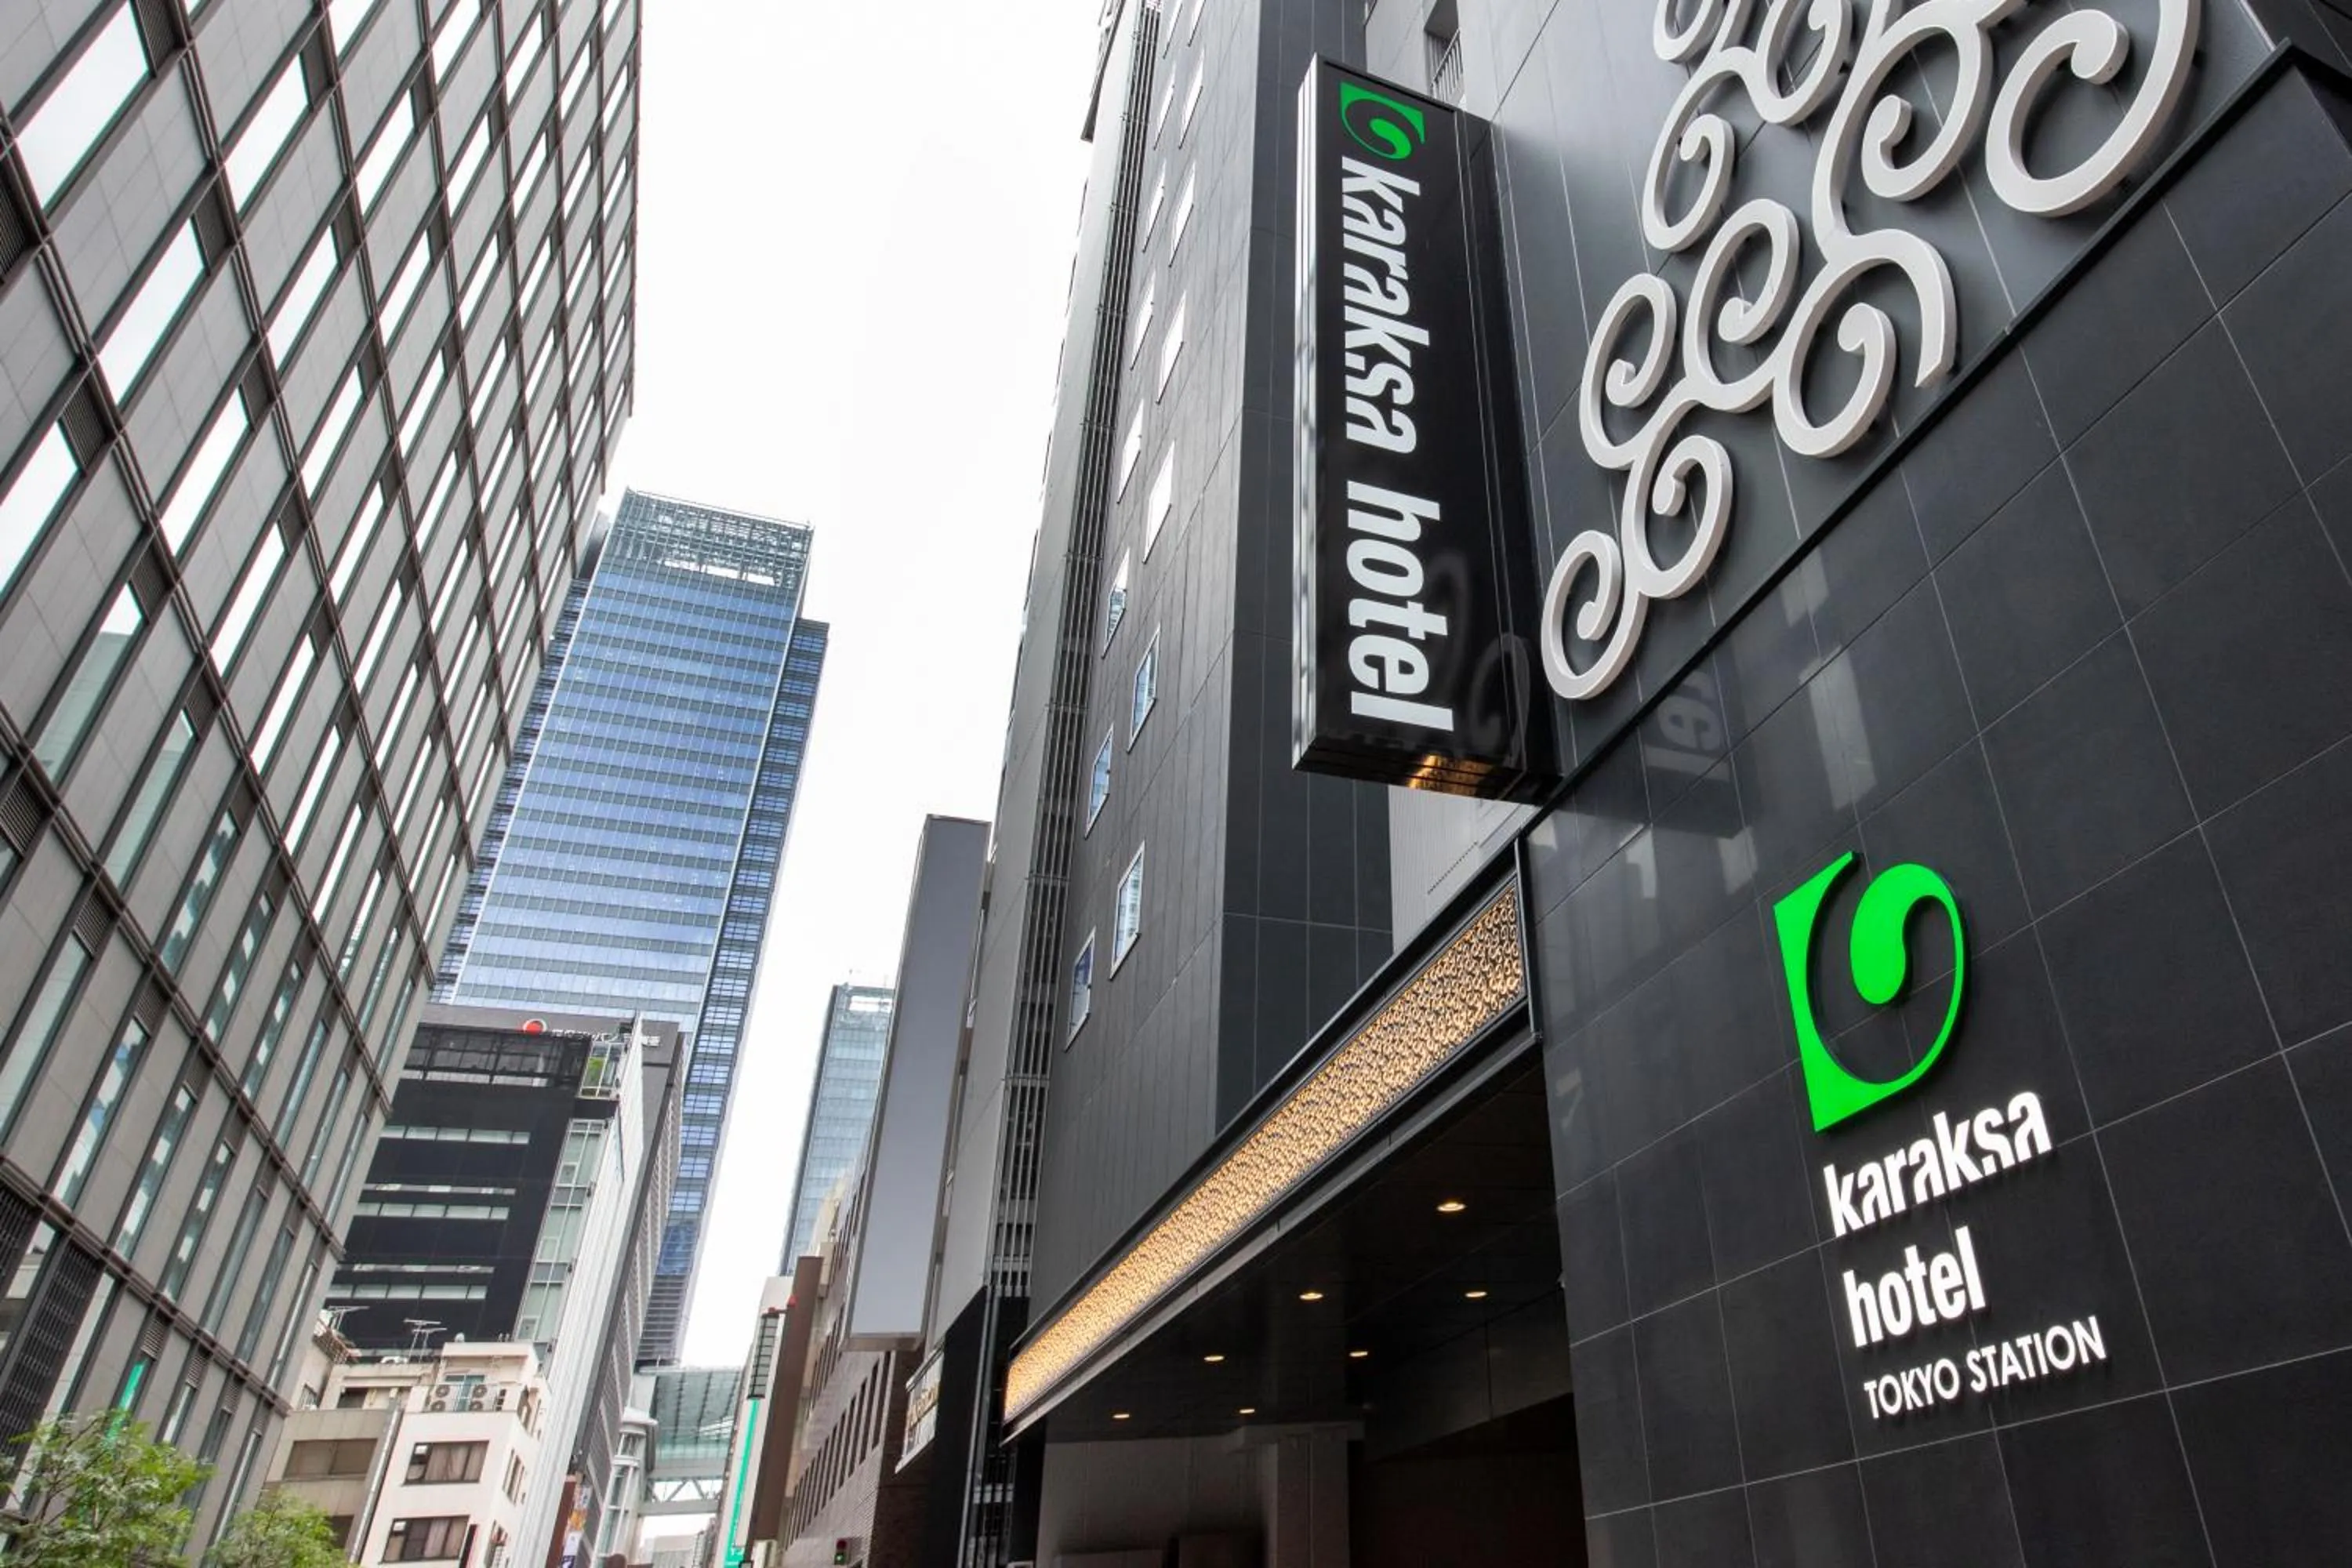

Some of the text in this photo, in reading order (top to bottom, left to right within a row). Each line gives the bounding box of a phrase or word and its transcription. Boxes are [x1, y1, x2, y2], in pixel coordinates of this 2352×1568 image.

[1341, 156, 1454, 731] karaksa hotel
[1823, 1091, 2052, 1238] karaksa
[1842, 1225, 1986, 1348] hotel
[1864, 1316, 2107, 1419] TOKYO STATION
